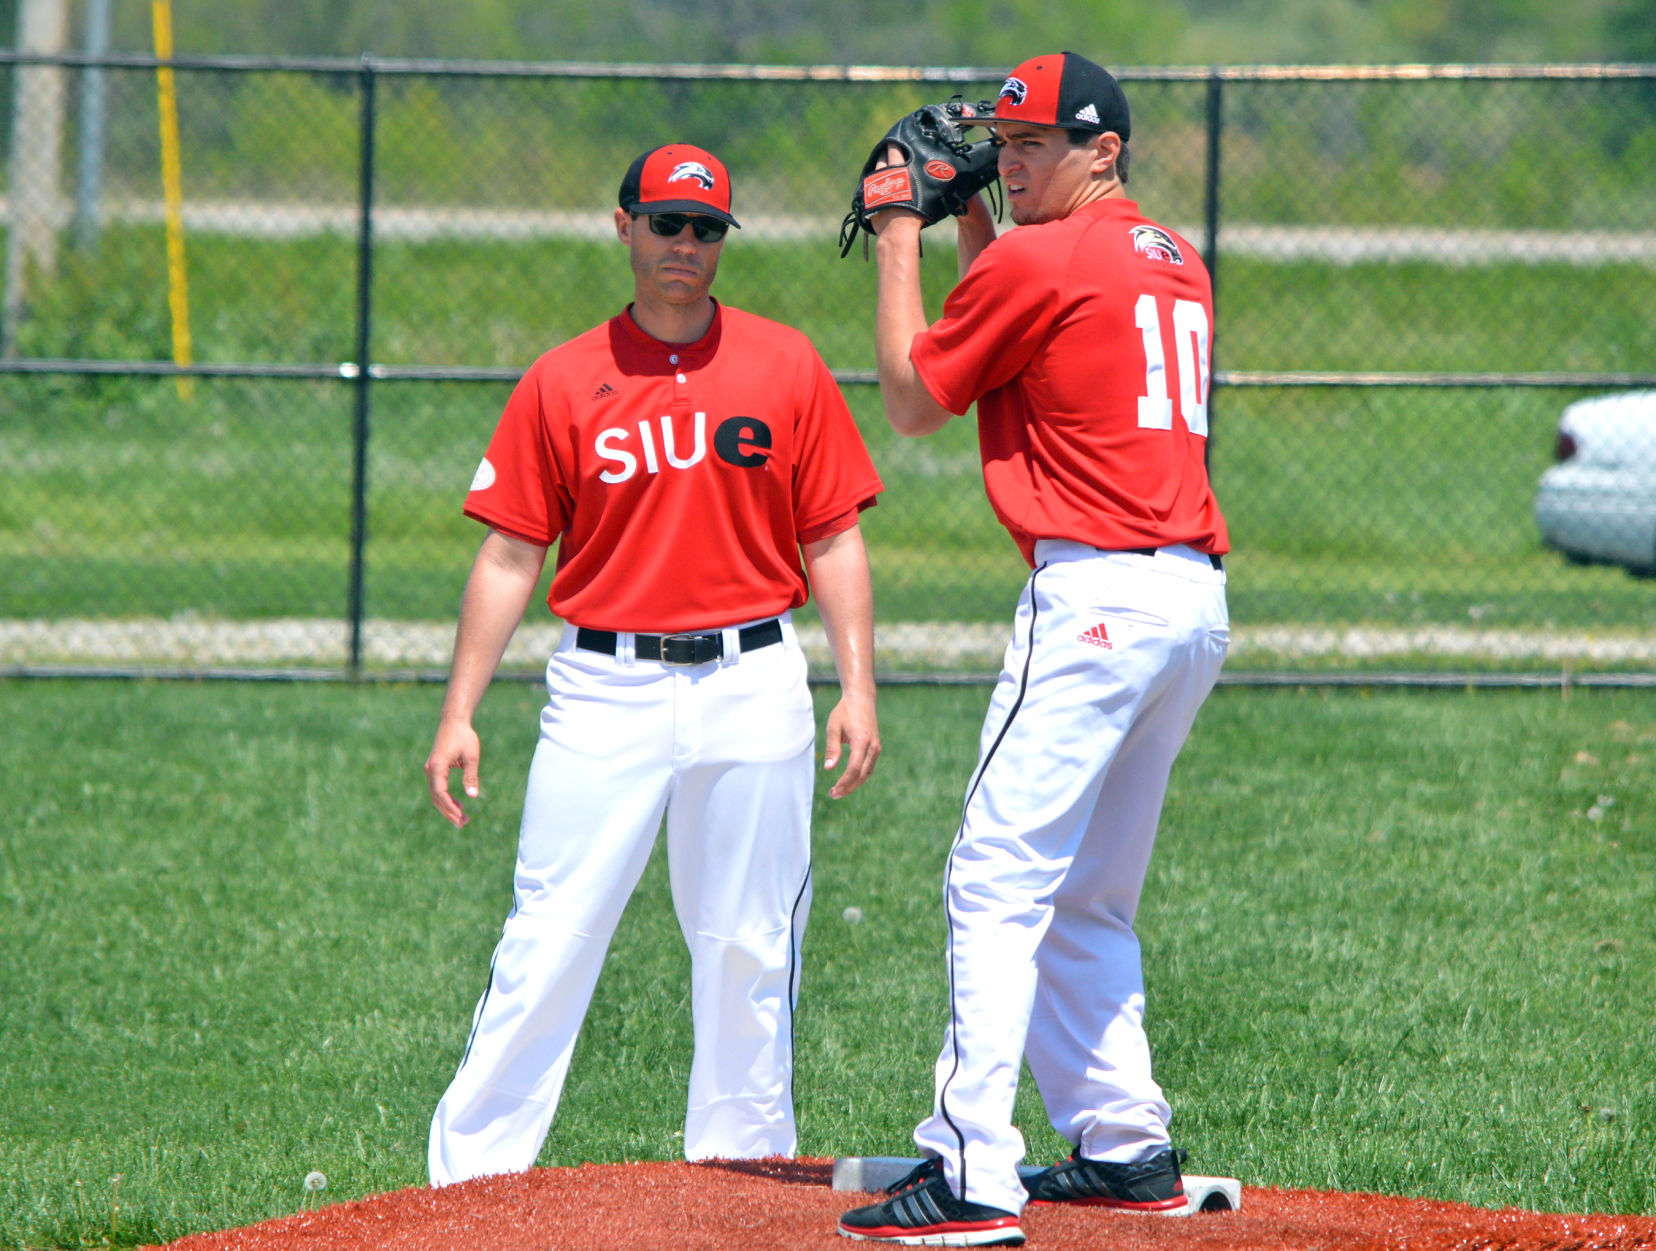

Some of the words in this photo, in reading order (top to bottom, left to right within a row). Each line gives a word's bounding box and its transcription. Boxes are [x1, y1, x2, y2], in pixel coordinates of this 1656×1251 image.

[1075, 112, 1100, 124] adidas
[1135, 294, 1209, 438] 10
[594, 411, 773, 484] SIUe
[1077, 634, 1113, 650] adidas
